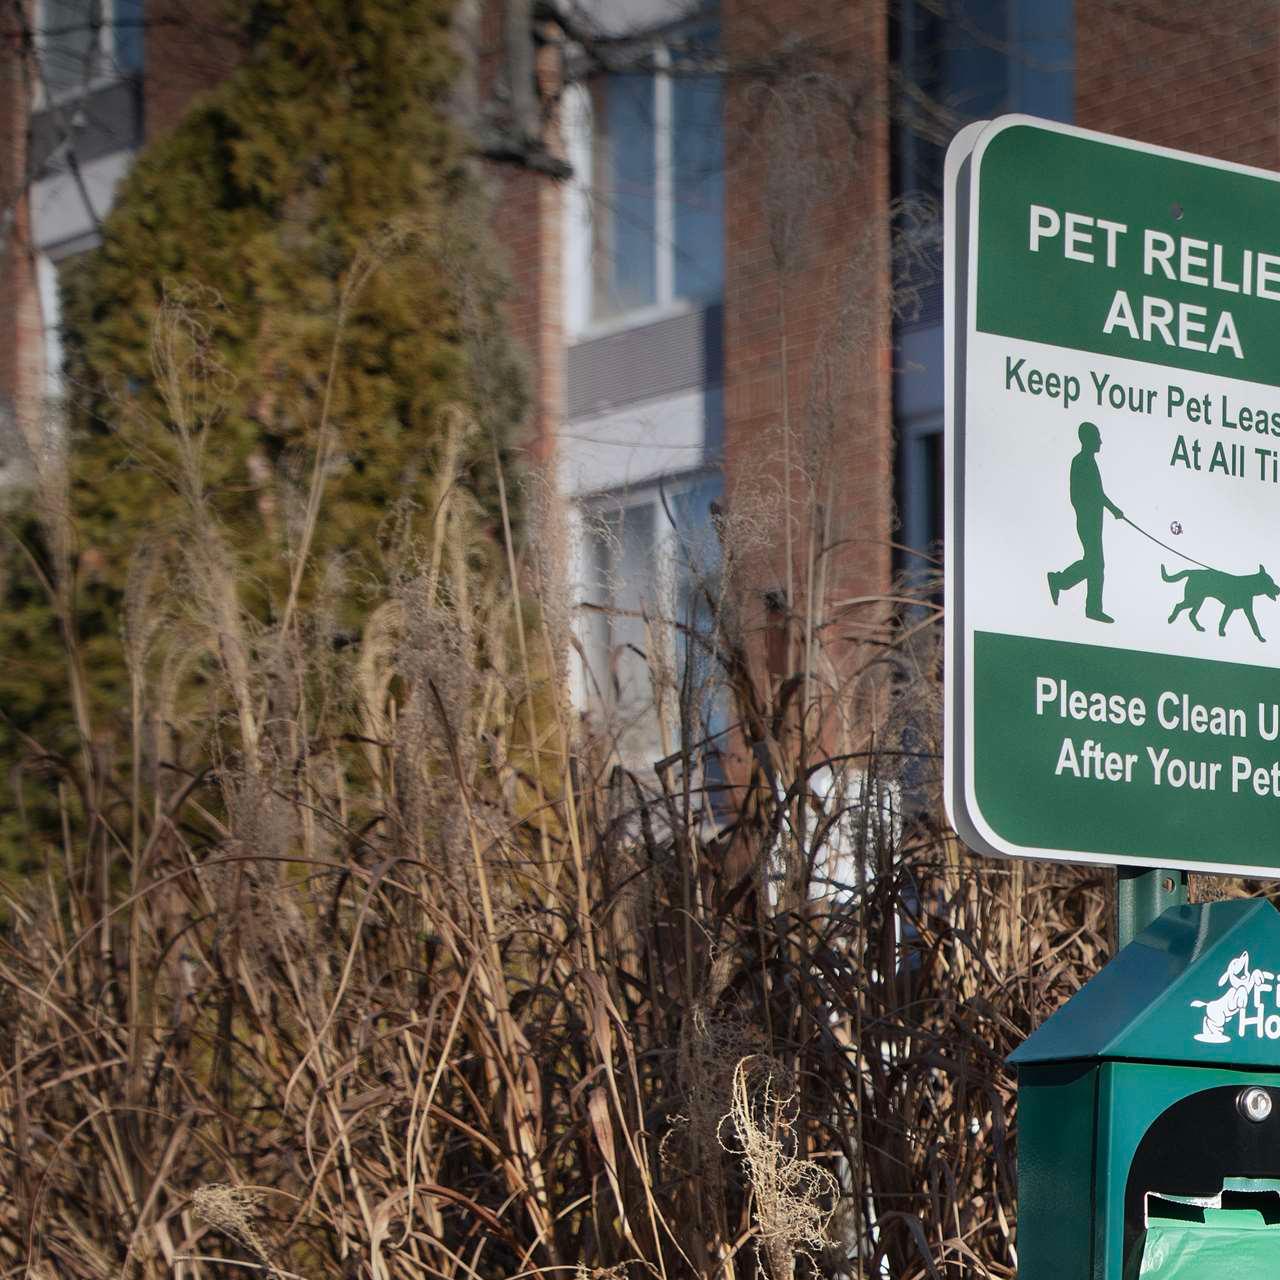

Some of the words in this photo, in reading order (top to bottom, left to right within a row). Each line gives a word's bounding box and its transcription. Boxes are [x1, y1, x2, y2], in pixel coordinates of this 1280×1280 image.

[1029, 204, 1128, 268] PET
[1102, 290, 1244, 359] AREA
[1005, 356, 1080, 408] Keep
[1090, 371, 1158, 414] Your
[1167, 385, 1212, 425] Pet
[1170, 435, 1201, 470] At
[1209, 441, 1245, 478] All
[1036, 676, 1146, 726] Please
[1157, 691, 1246, 738] Clean
[1055, 738, 1138, 783] After
[1146, 746, 1222, 791] Your
